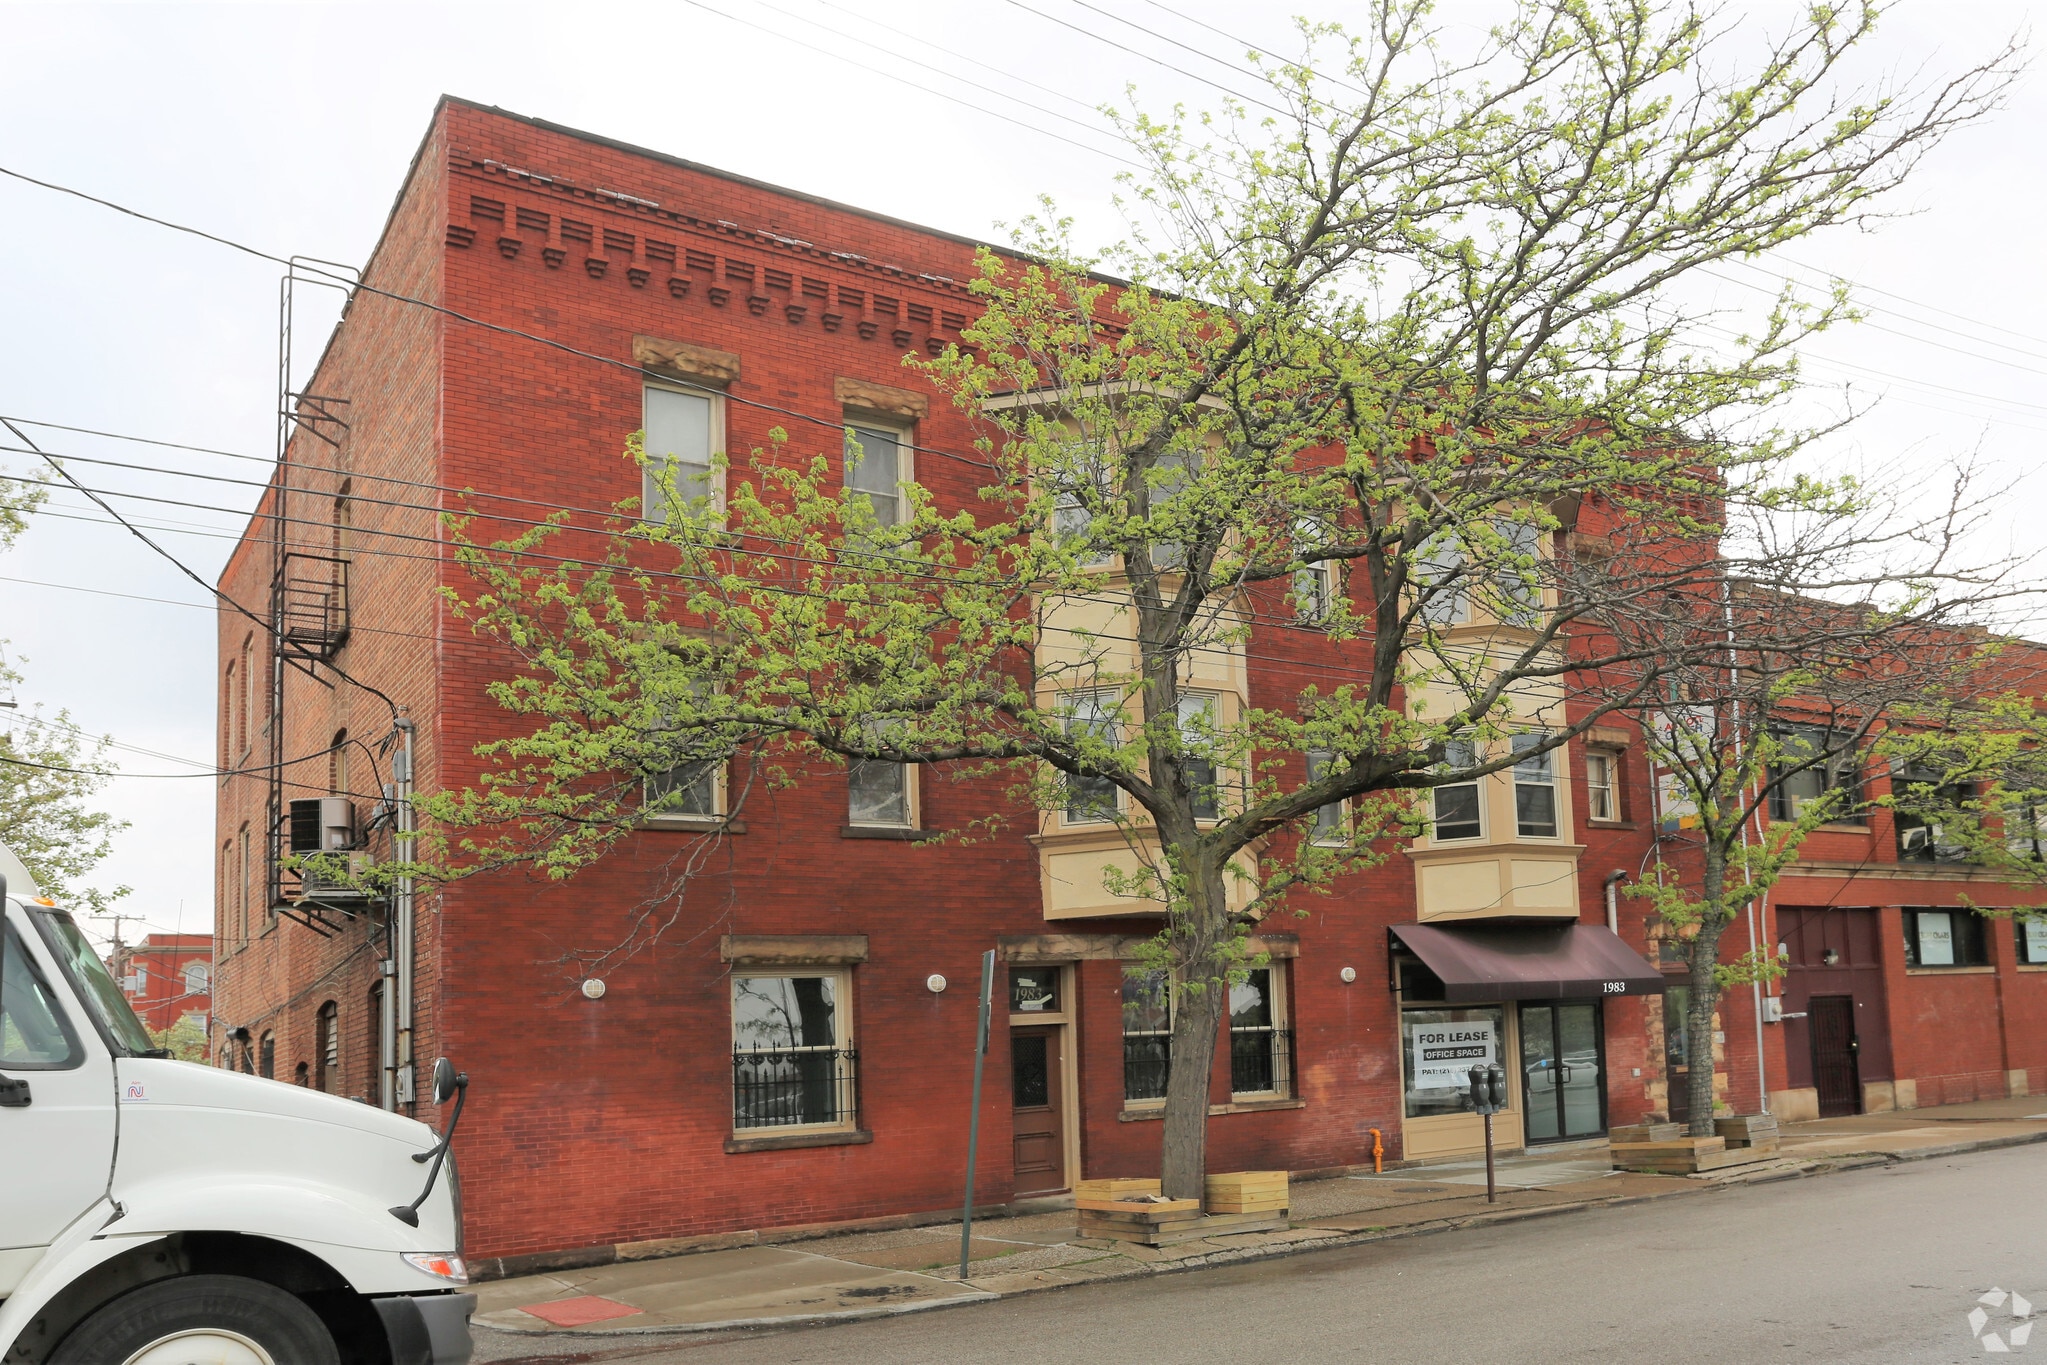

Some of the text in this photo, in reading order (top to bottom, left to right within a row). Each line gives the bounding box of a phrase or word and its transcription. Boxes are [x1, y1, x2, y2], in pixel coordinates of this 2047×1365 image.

[1603, 982, 1625, 993] 1983
[1015, 987, 1042, 1001] 1983
[1419, 1031, 1489, 1044] FOR LEASE
[1426, 1048, 1484, 1059] OFFICE SPACE
